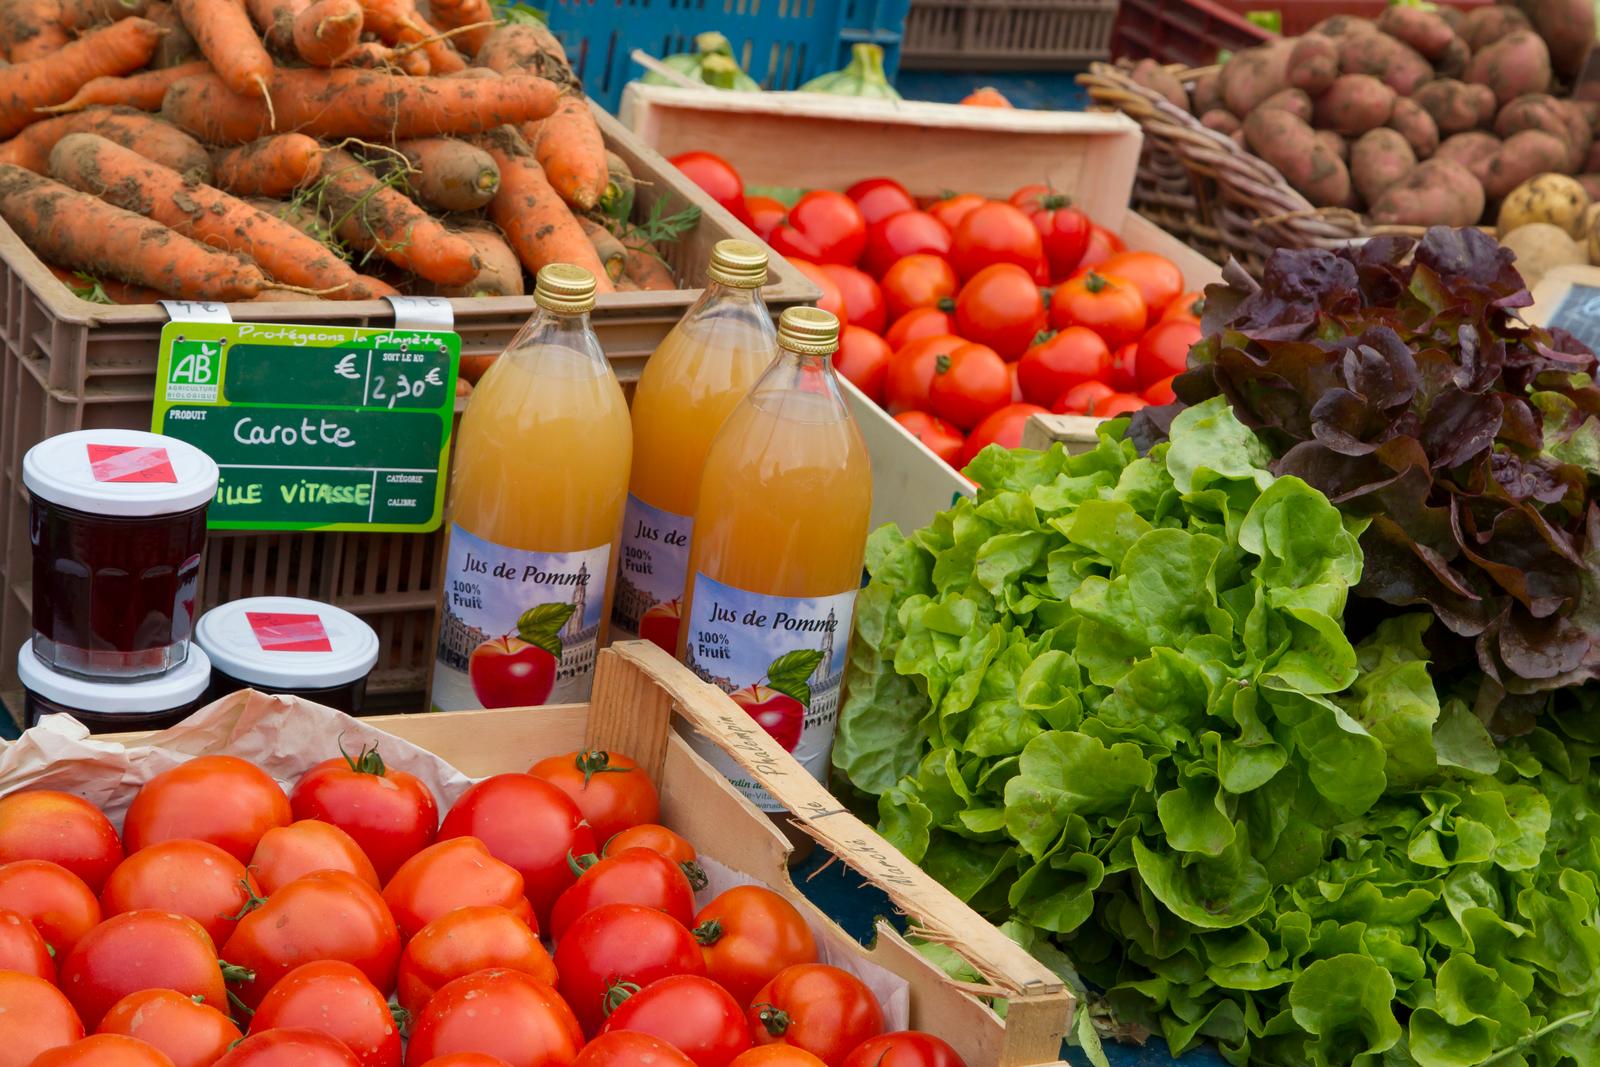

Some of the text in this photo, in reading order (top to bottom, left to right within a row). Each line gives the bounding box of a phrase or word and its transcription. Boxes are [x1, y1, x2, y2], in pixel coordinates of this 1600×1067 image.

[238, 325, 444, 349] Protégeons la planète
[334, 353, 361, 379] €
[382, 353, 425, 363] SOIT LE KG
[172, 353, 212, 383] AB
[167, 392, 217, 400] BIOLOGIQUE
[168, 385, 217, 393] AGRICULTURE
[169, 410, 207, 420] PRODUIT
[233, 417, 356, 447] Carotte
[386, 474, 424, 483] CATÉGORIE
[387, 498, 417, 507] CALIBRE
[634, 520, 687, 547] Jus de
[625, 546, 652, 561] 100%
[462, 553, 592, 586] Jus de Pomme
[625, 559, 653, 575] Fruit
[453, 580, 481, 596] 100%
[453, 593, 483, 610] Fruit
[709, 602, 839, 633] Jus de Pomme
[698, 631, 730, 645] 100%
[698, 644, 731, 660] Fruit
